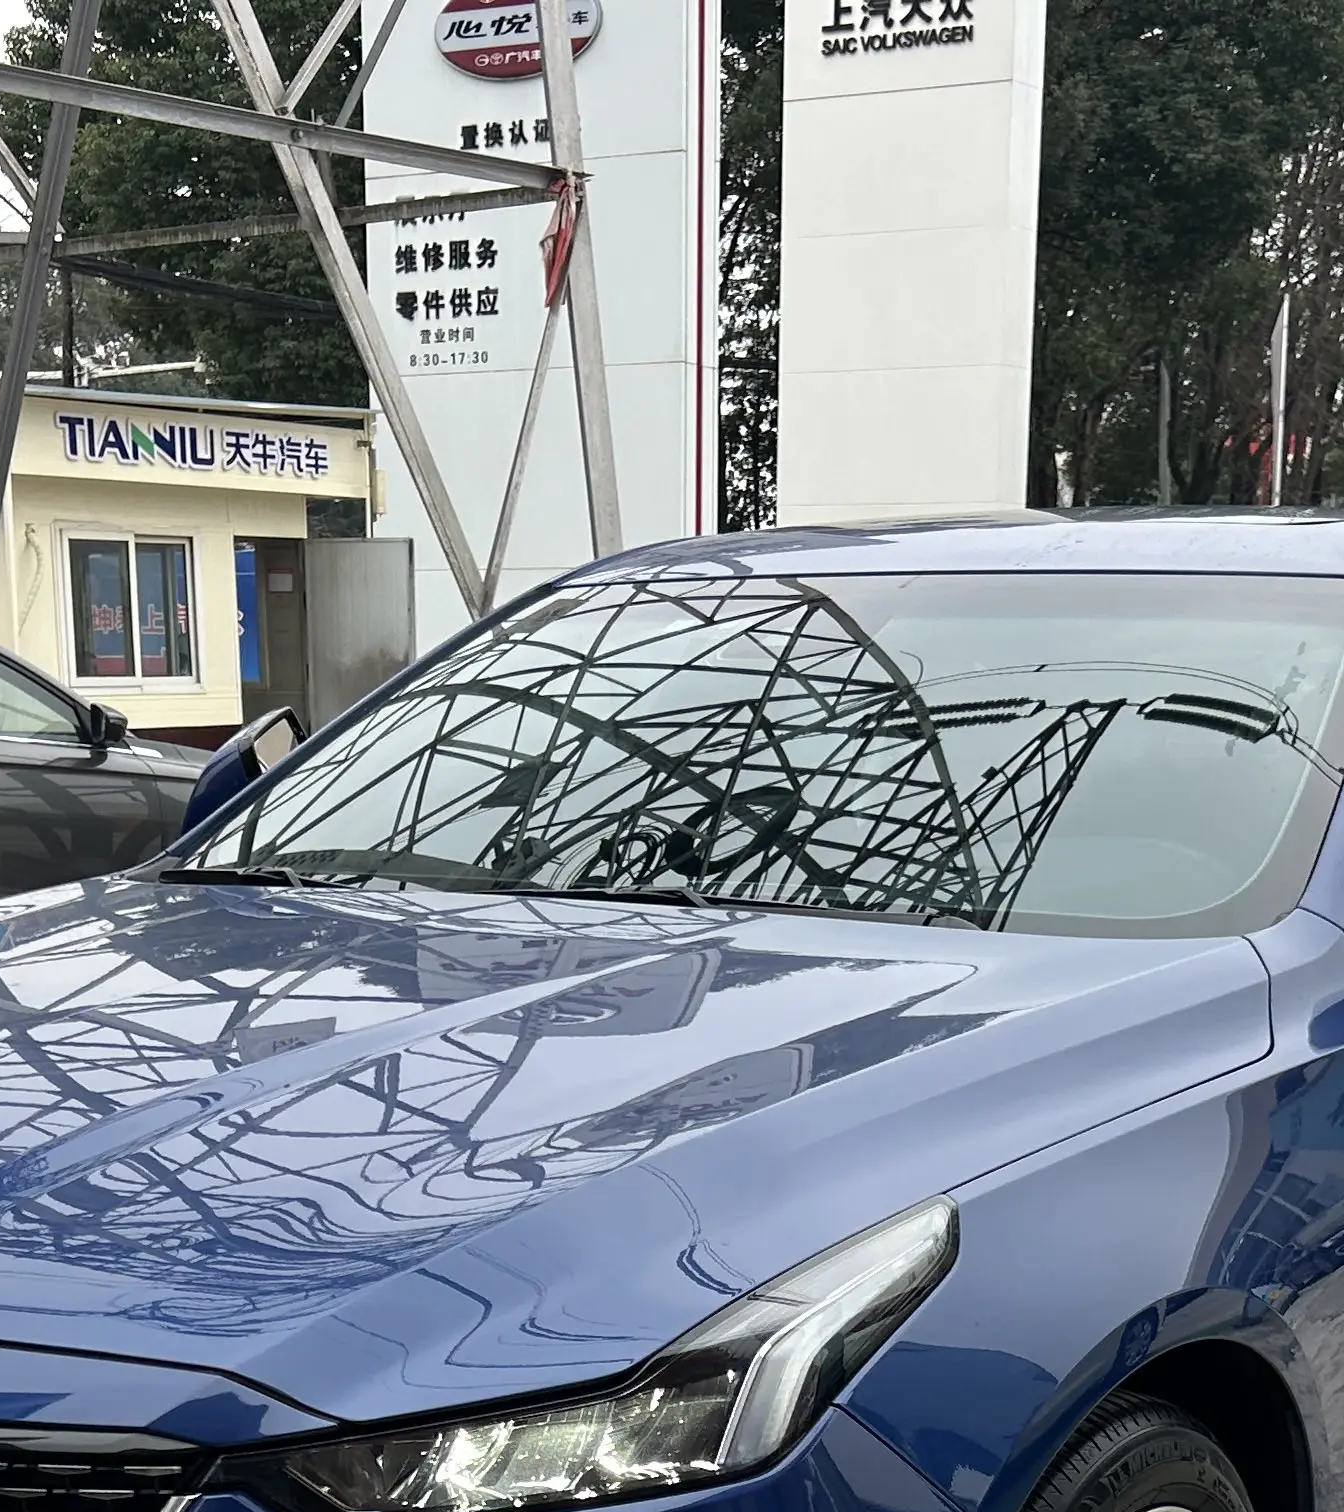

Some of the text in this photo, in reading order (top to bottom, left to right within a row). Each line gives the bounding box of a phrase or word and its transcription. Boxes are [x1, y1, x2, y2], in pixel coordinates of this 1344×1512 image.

[821, 25, 974, 56] SAIC VOLKSWAGEN
[460, 118, 551, 150] 置换认证
[395, 238, 499, 275] 维修服务
[395, 286, 499, 321] 零件供应
[420, 327, 475, 344] 营业时间
[409, 351, 489, 367] 8:30-17:30
[58, 415, 329, 475] TIANNIU 天牛汽车
